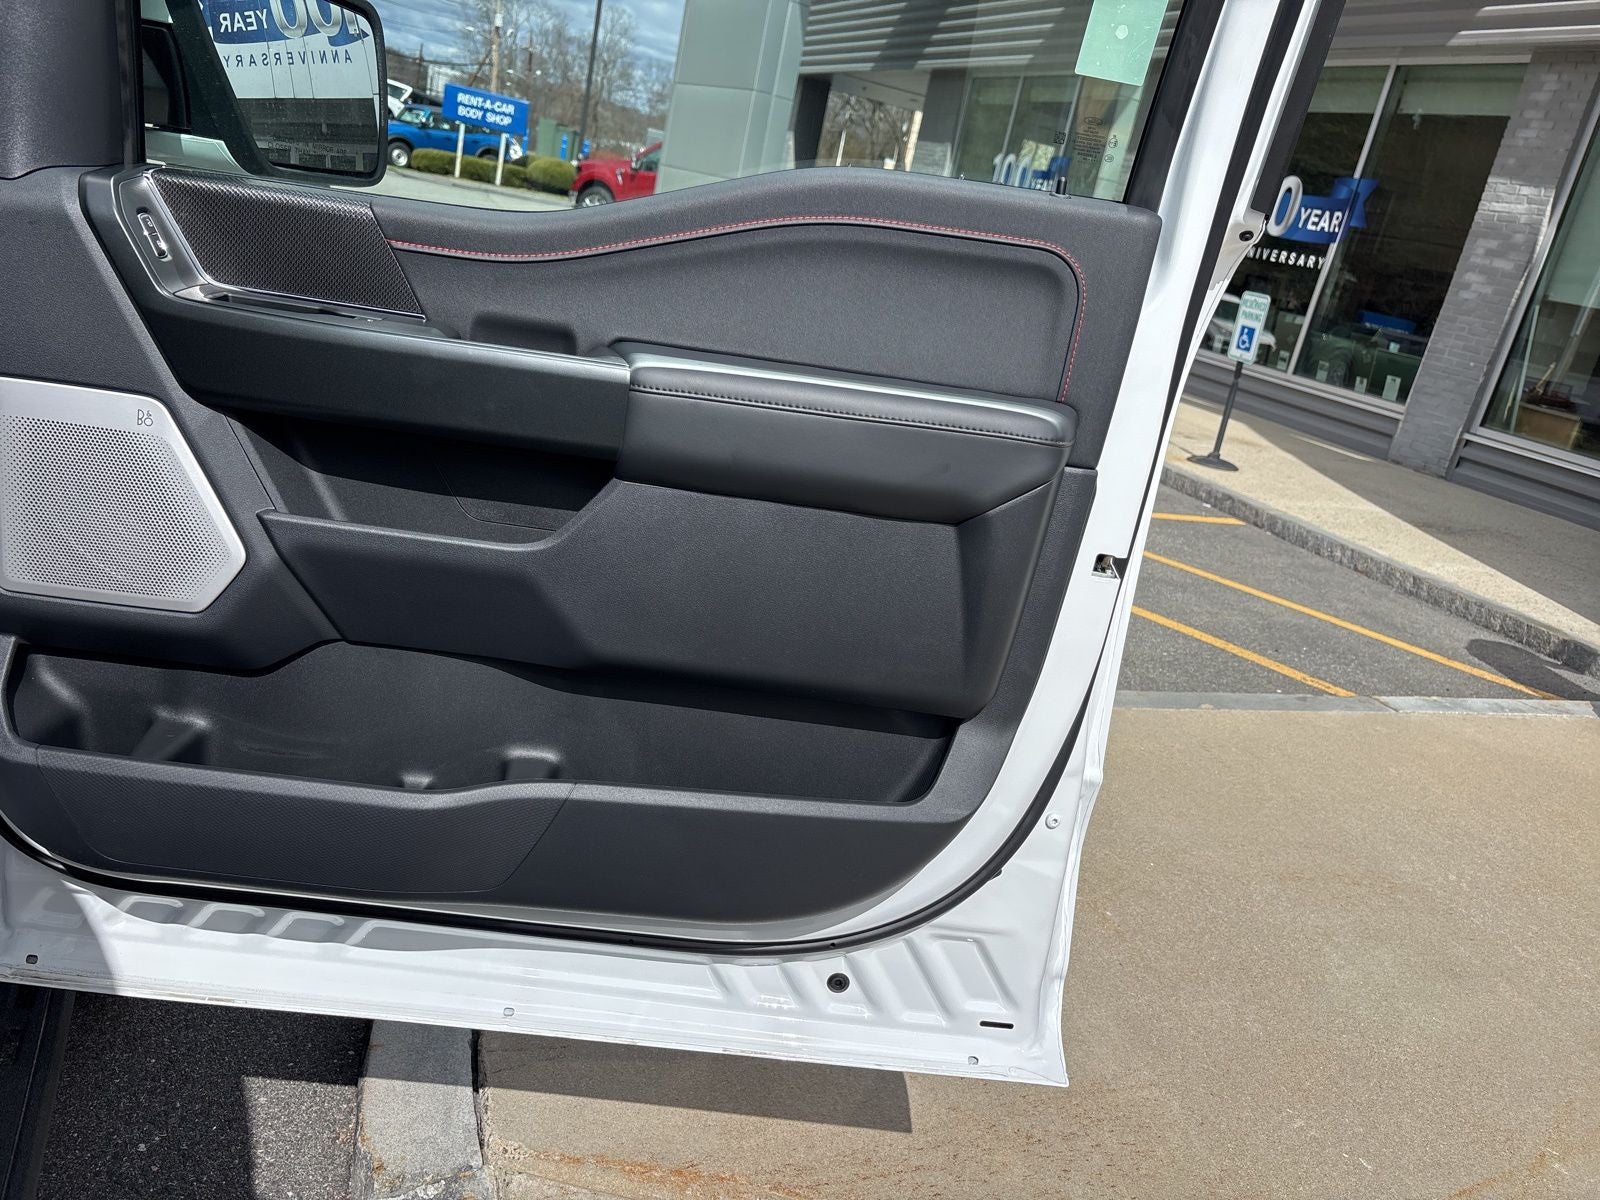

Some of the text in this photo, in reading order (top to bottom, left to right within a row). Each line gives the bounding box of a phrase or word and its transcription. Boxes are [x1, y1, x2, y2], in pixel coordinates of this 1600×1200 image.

[457, 92, 515, 115] RENT-A-CAR
[457, 105, 513, 126] BODY SHOP
[1298, 207, 1343, 233] YEAR
